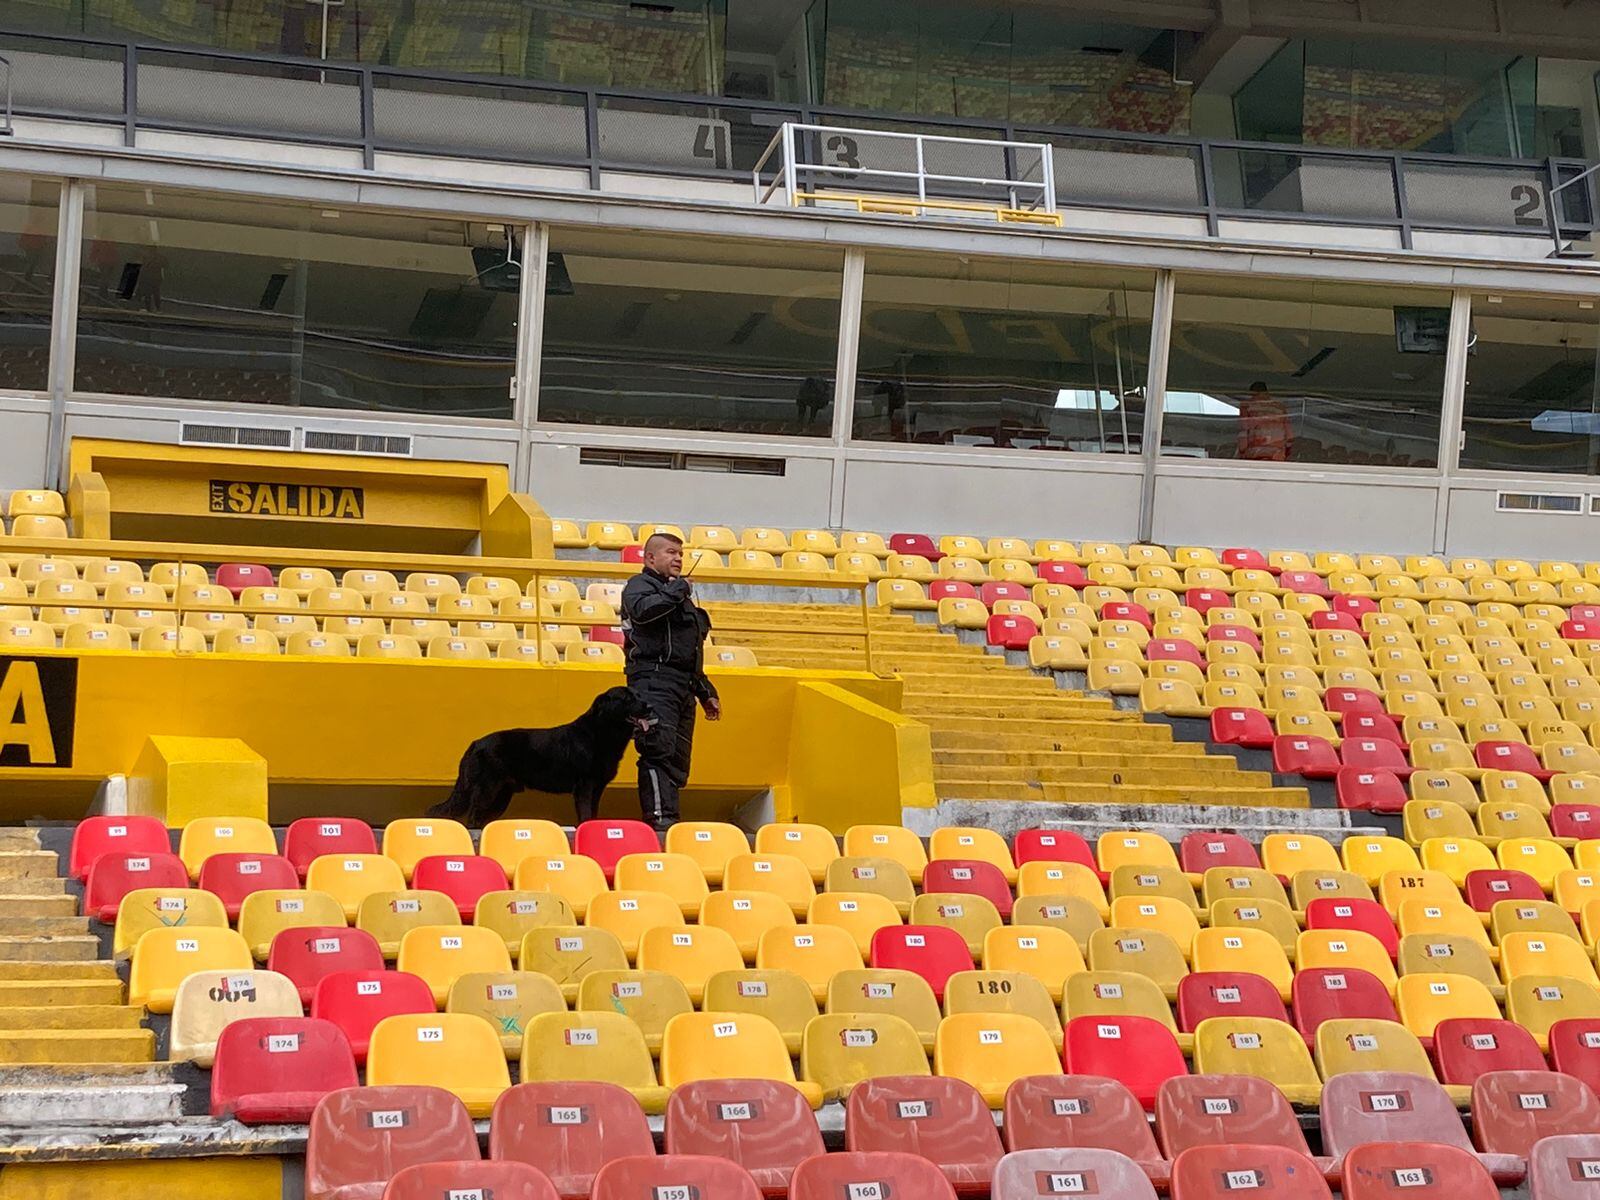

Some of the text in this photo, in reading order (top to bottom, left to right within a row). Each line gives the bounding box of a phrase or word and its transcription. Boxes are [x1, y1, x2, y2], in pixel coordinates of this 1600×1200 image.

[693, 125, 726, 168] 4
[827, 136, 860, 179] 3
[1511, 185, 1543, 226] 2
[212, 484, 224, 511] EXIT
[228, 483, 362, 518] SALIDA
[0, 660, 57, 763] A
[1399, 876, 1424, 887] 187
[234, 980, 250, 988] 174
[977, 980, 1012, 994] 180
[1221, 992, 1235, 1000] 182
[718, 1025, 733, 1034] 177
[275, 1040, 293, 1048] 174
[1476, 1038, 1490, 1046] 183
[1377, 1098, 1394, 1107] 170
[1525, 1097, 1541, 1105] 171
[727, 1106, 746, 1116] 166
[904, 1105, 921, 1114] 167
[1059, 1103, 1076, 1112] 168
[1210, 1102, 1227, 1111] 169
[378, 1115, 399, 1124] 164
[557, 1111, 577, 1120] 165
[1057, 1178, 1077, 1187] 161
[1232, 1175, 1253, 1185] 162
[1400, 1173, 1420, 1183] 163
[663, 1190, 685, 1200] 159
[855, 1186, 876, 1197] 160
